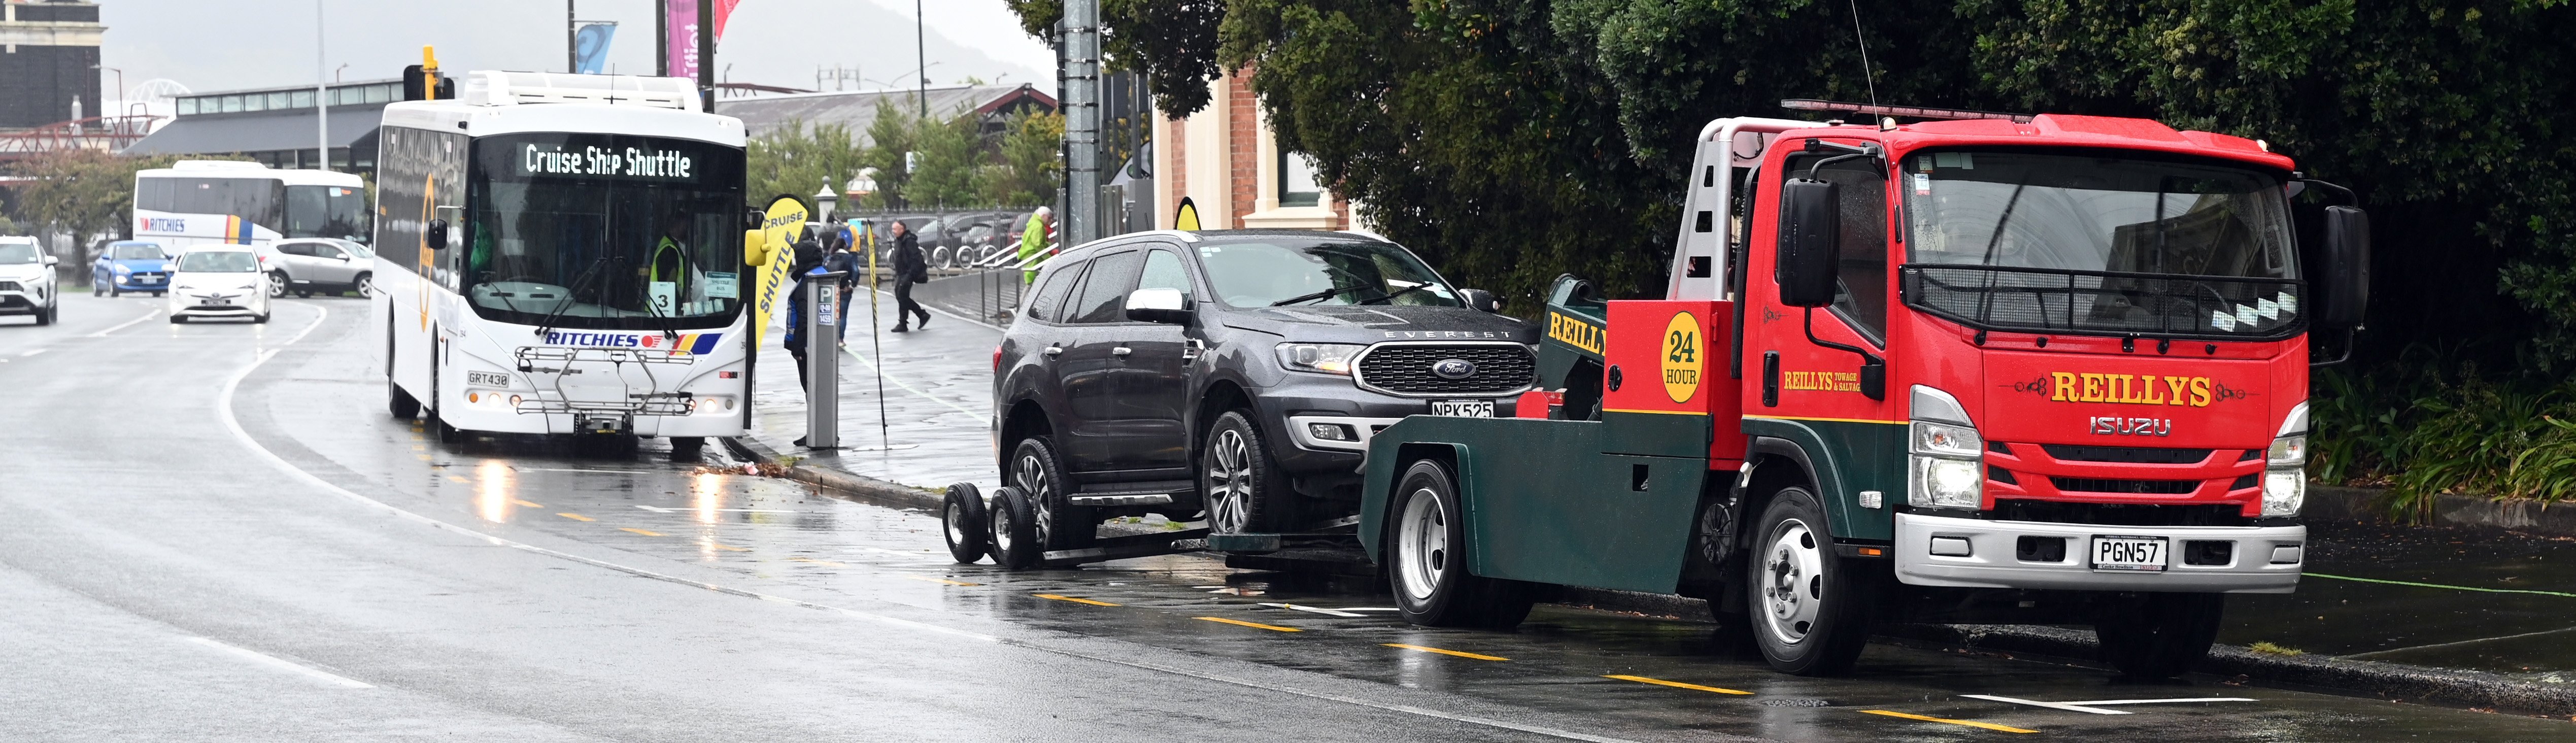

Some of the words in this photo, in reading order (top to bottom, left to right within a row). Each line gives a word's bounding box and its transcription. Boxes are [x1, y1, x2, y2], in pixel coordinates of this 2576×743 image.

[526, 144, 581, 174] Cruise
[586, 146, 621, 175] Ship
[626, 147, 691, 178] Shuttle
[150, 218, 185, 232] RITCHIES
[764, 211, 803, 229] CRUISE
[760, 231, 795, 313] SHUTTLE
[658, 294, 668, 308] 3
[820, 287, 832, 302] P
[545, 332, 638, 347] RITCHIES
[1669, 330, 1694, 363] 24
[1445, 362, 1466, 373] Ford
[469, 373, 507, 385] GRT430
[1666, 369, 1697, 384] HOUR
[1784, 371, 1833, 391] REILLYS
[1834, 373, 1856, 381] TOWAGE
[1834, 382, 1838, 391] &
[1839, 383, 1861, 392] SALVAG
[2051, 372, 2211, 407] REILLYS
[1434, 403, 1492, 418] NPK525
[2090, 416, 2171, 436] ISUZU
[2101, 542, 2158, 563] PGN57
